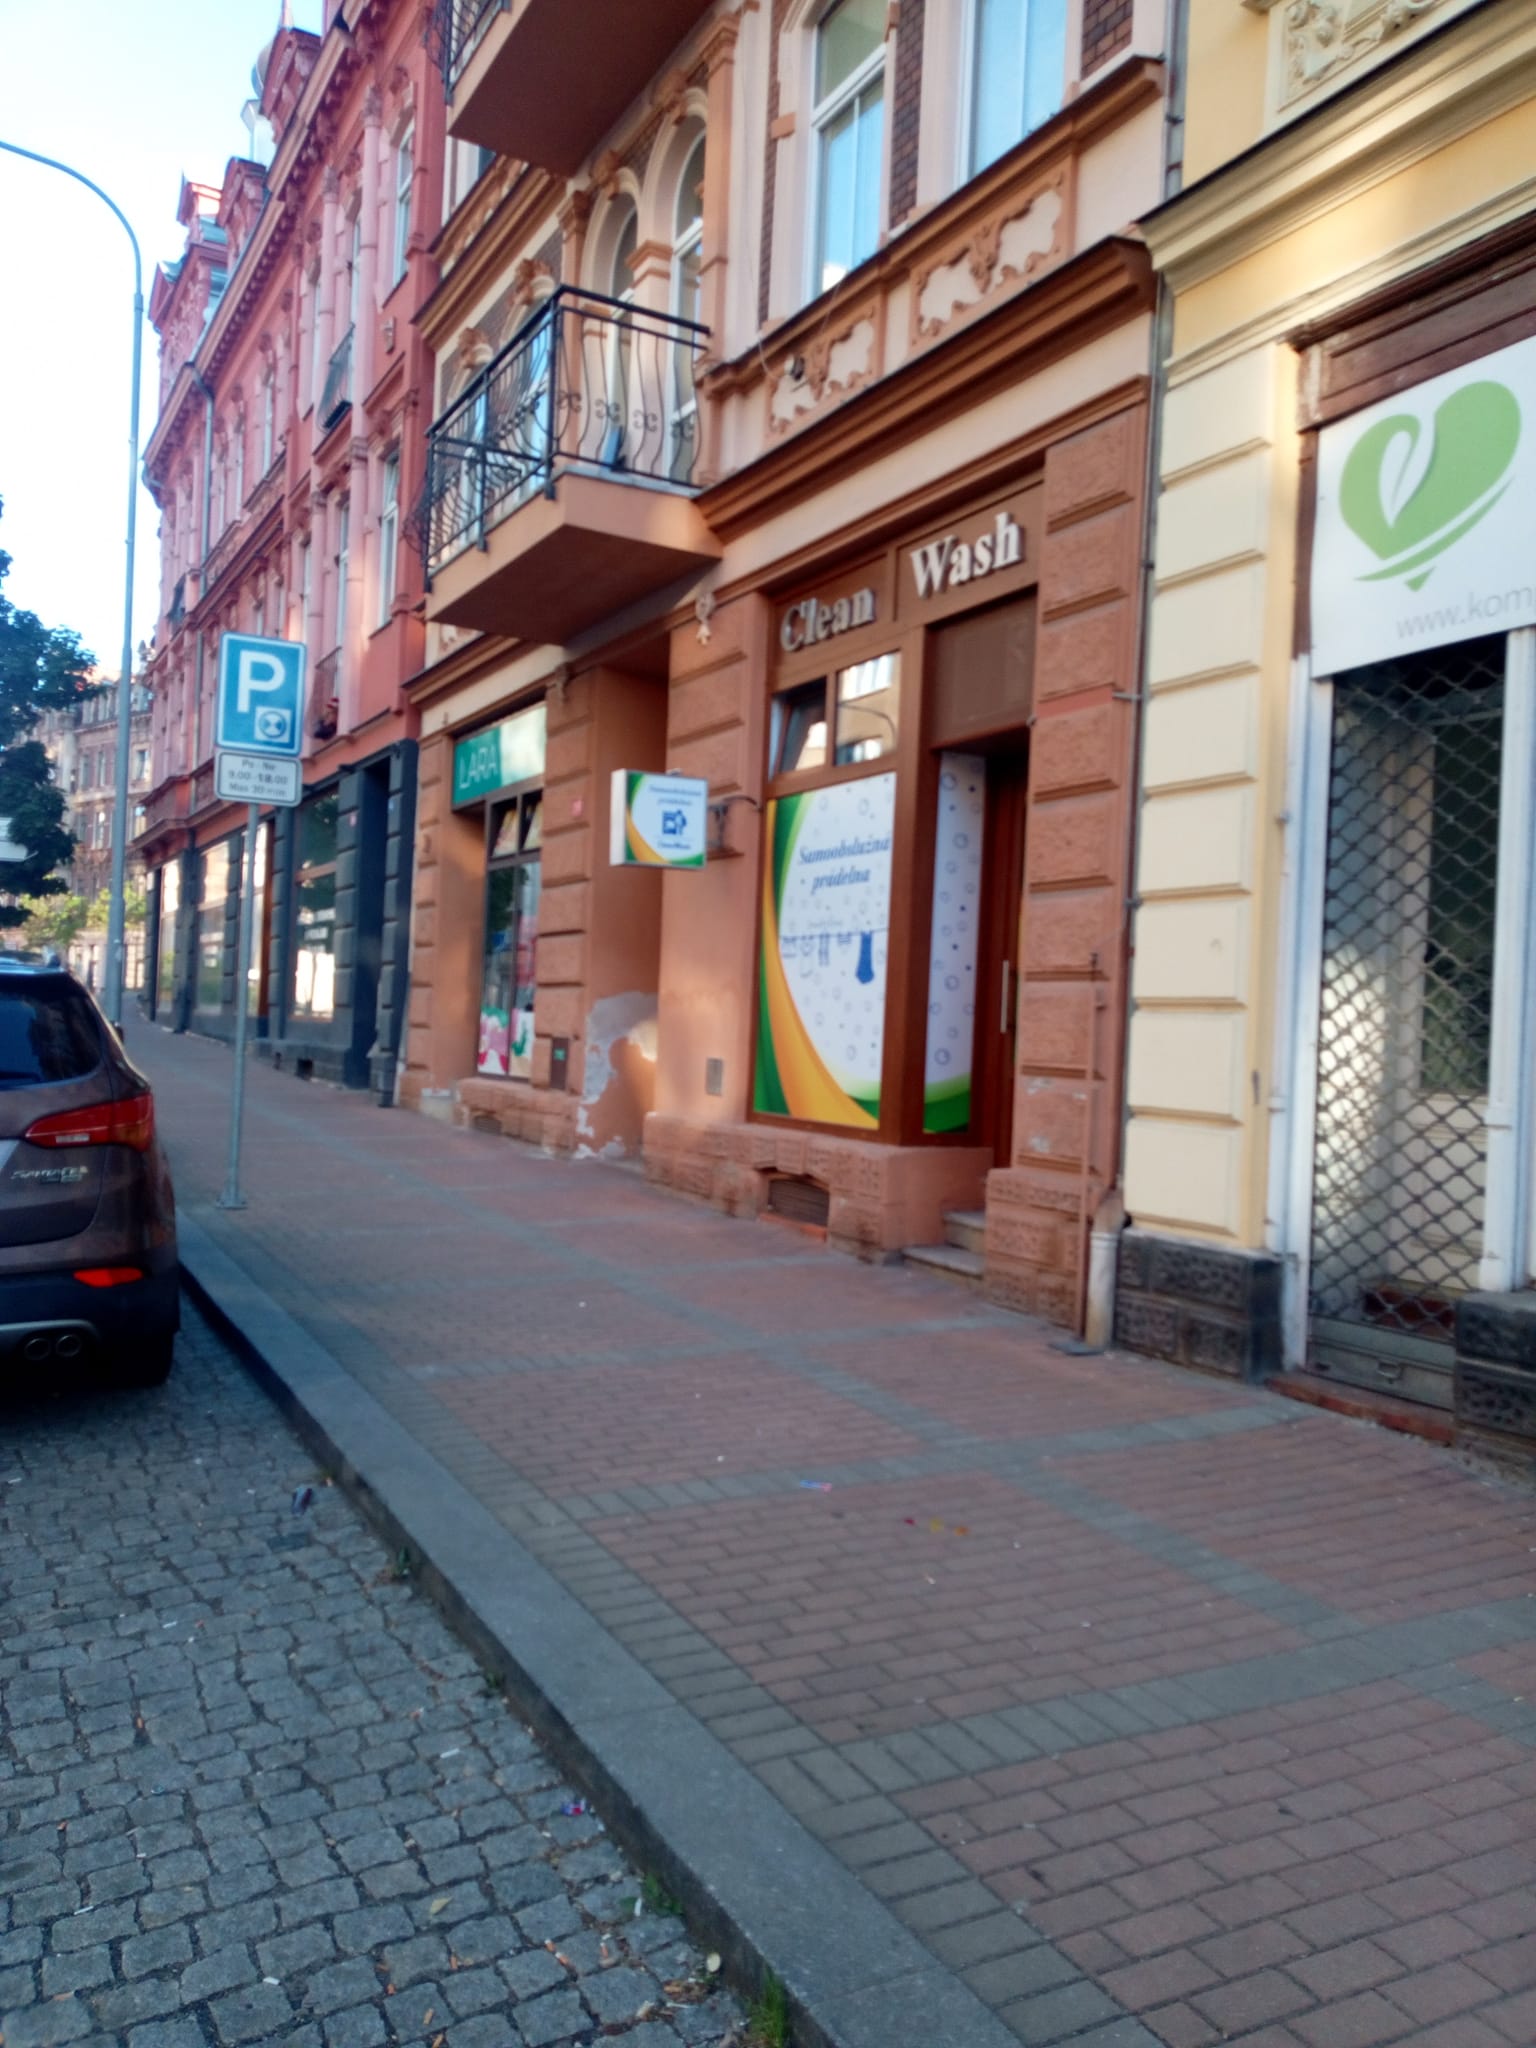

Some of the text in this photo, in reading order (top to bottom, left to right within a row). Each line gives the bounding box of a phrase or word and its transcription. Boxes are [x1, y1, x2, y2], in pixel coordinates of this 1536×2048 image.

[780, 512, 1024, 652] Clean Wash
[1395, 586, 1536, 639] www.kom
[237, 649, 285, 713] P
